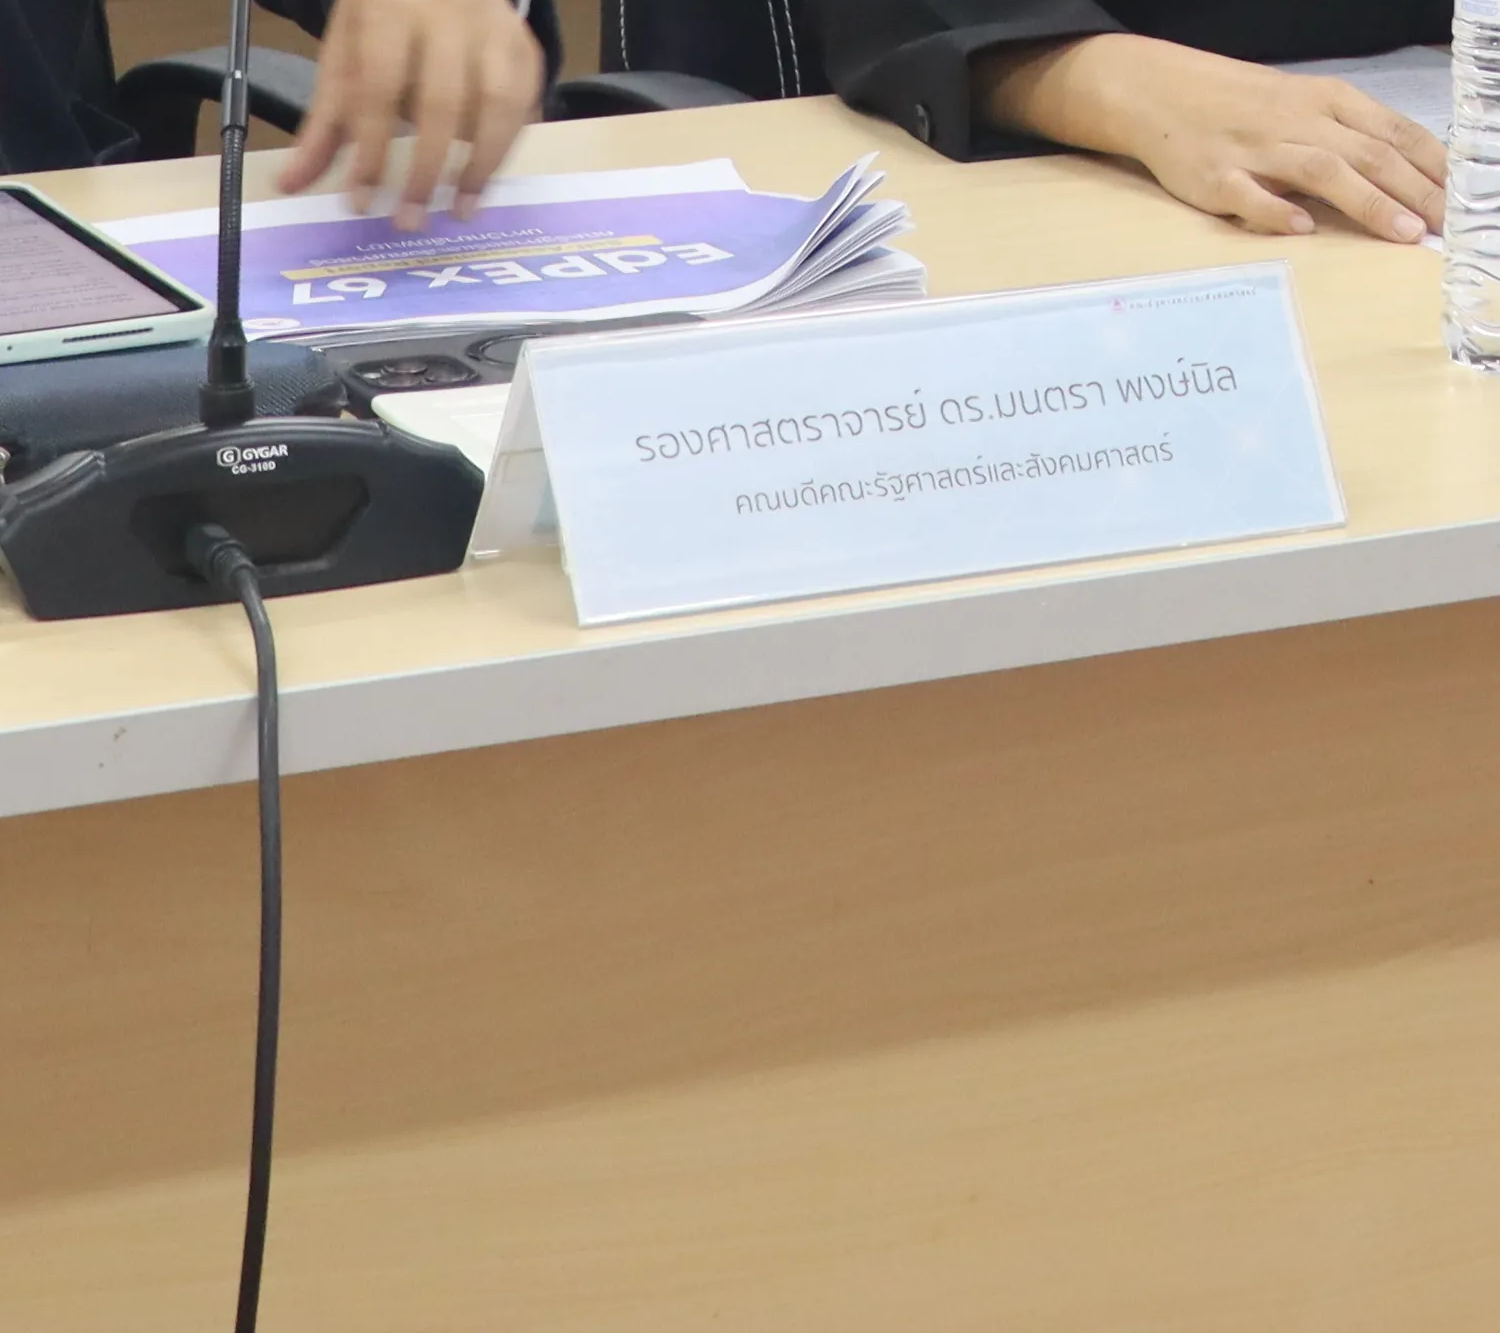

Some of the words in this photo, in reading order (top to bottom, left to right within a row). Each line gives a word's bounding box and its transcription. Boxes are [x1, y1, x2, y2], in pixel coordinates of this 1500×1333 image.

[406, 241, 736, 290] EdPEx
[291, 276, 388, 306] 67
[635, 387, 927, 463] รองศาสตราจารย์
[939, 380, 1106, 425] ดร.มนตรา
[1115, 356, 1239, 404] พงษ์นิล
[242, 443, 289, 461] GYGAR
[735, 432, 1174, 515] คณบดีคณะรัฐศาสตร์และสังคมศาสตร์
